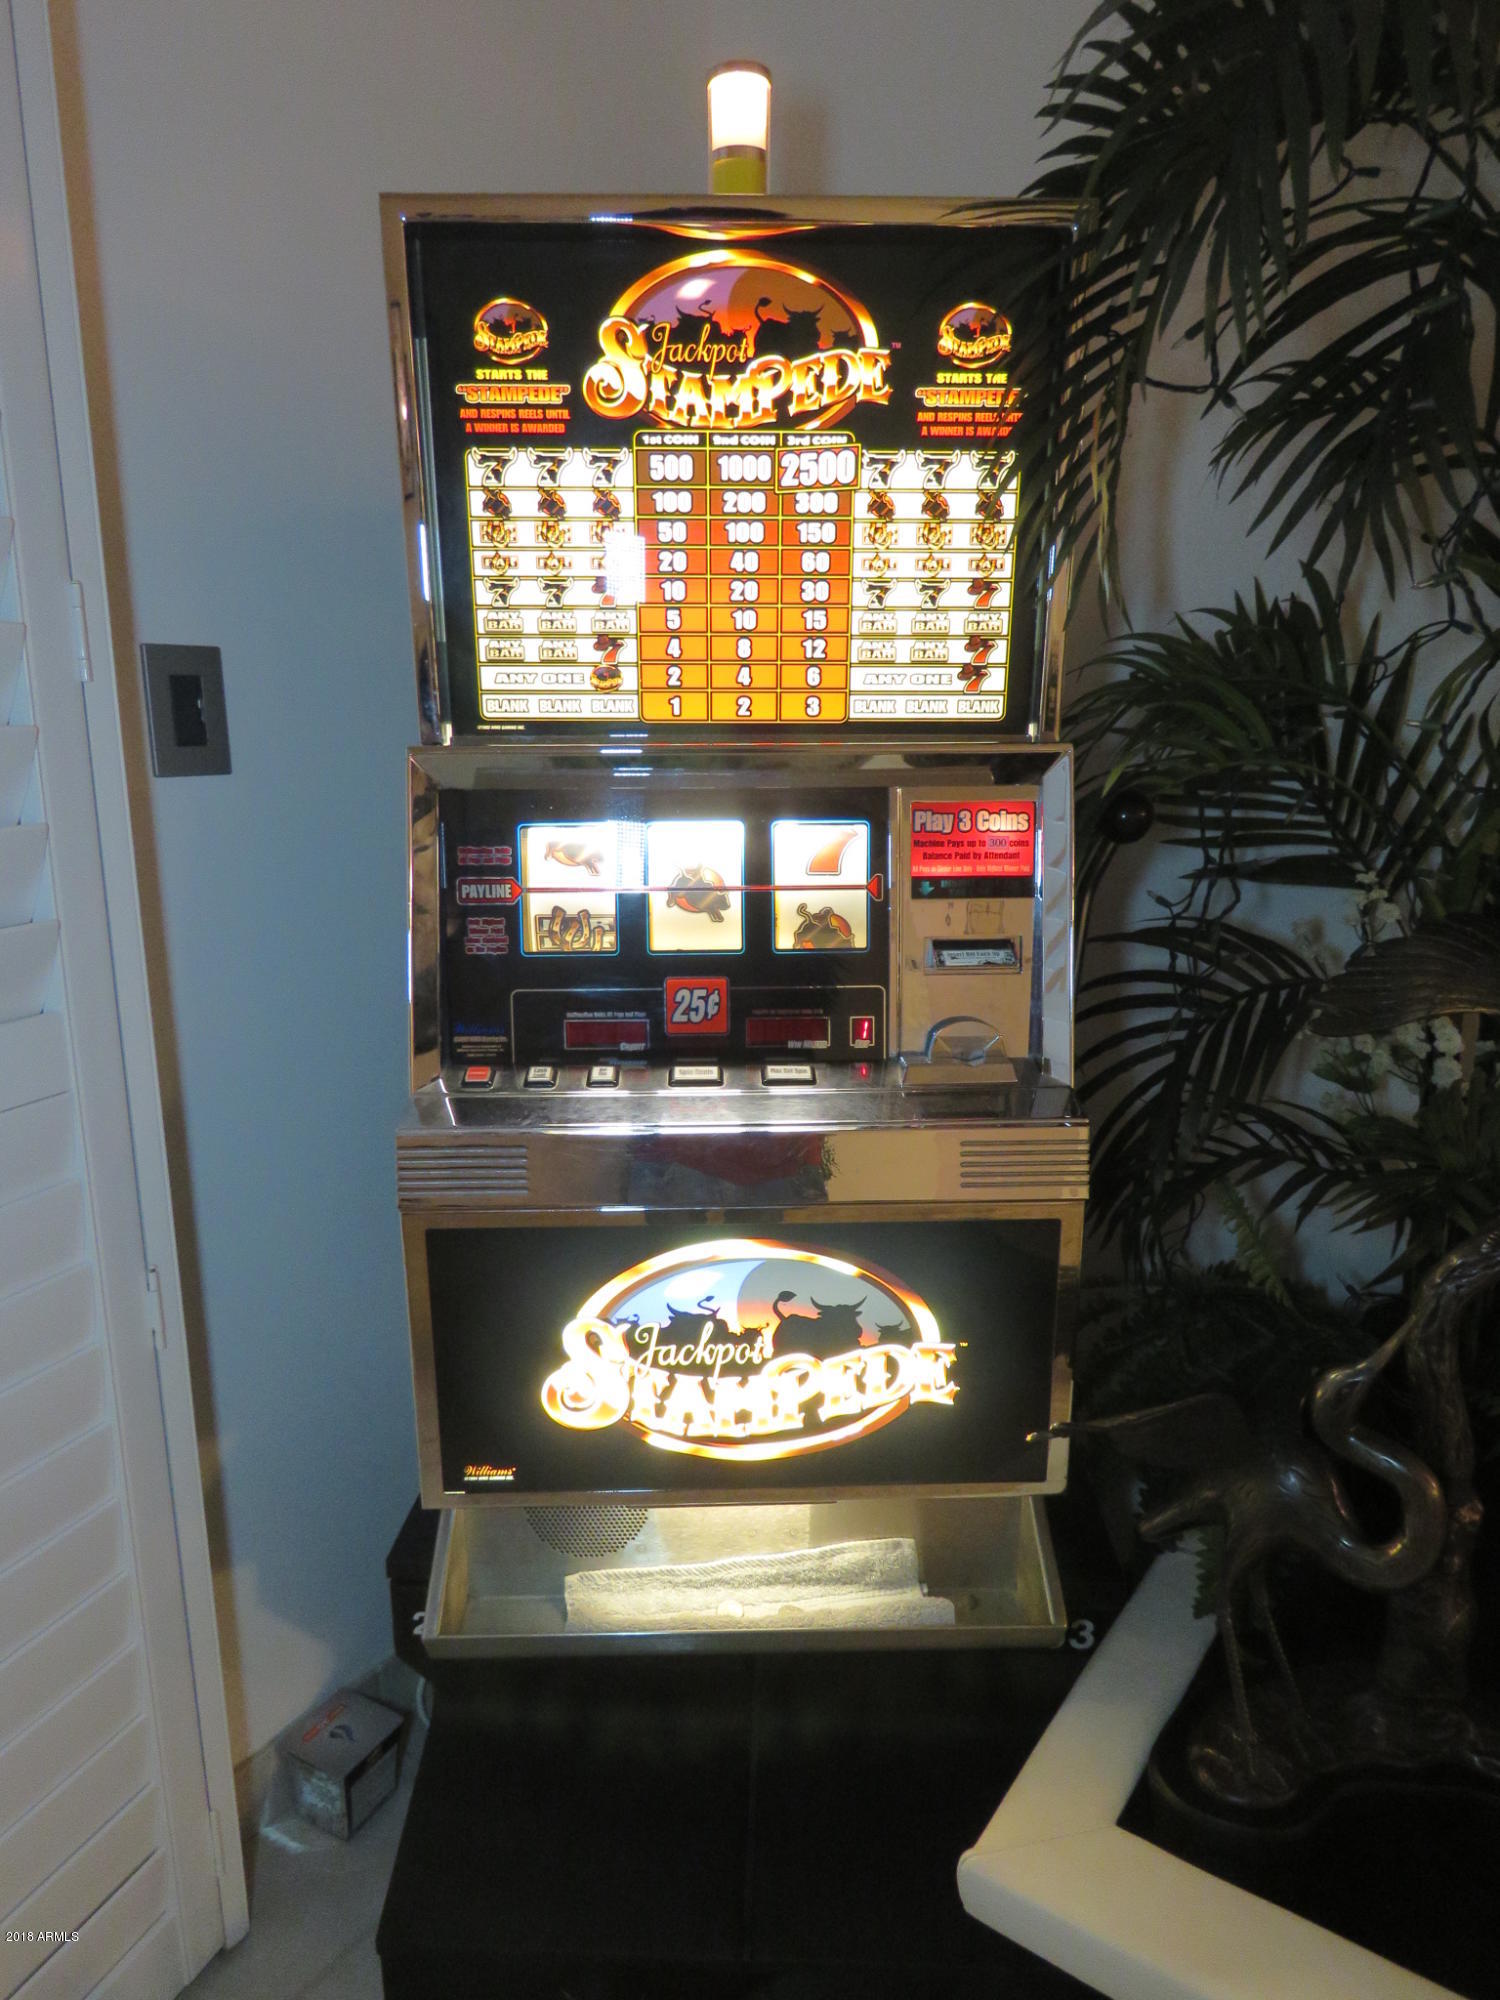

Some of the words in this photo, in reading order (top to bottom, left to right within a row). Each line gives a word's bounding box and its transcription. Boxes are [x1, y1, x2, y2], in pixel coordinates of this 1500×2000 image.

[652, 323, 748, 380] Jackpot
[476, 369, 522, 380] STARTS
[525, 369, 548, 380] THE
[583, 316, 894, 428] STAMPEDE
[936, 373, 982, 384] STARTS
[460, 409, 478, 419] AND
[518, 409, 544, 419] REELS
[546, 409, 571, 419] UNTIL
[917, 412, 935, 422] AND
[650, 454, 693, 482] 500
[718, 454, 772, 482] 1000
[780, 450, 856, 486] 2500
[652, 491, 692, 513] 100
[723, 491, 767, 513] 200
[795, 492, 839, 514] 300
[657, 521, 687, 543] 50
[725, 521, 765, 543] 100
[797, 521, 836, 543] 150
[658, 551, 687, 572] 20
[730, 551, 759, 572] 40
[801, 551, 831, 573] 60
[660, 580, 687, 601] 10
[730, 580, 759, 602] 20
[801, 580, 830, 602] 30
[666, 608, 681, 630] 5
[731, 609, 758, 630] 10
[802, 609, 828, 631] 15
[666, 637, 682, 658] 4
[737, 638, 752, 659] 8
[802, 638, 827, 659] 12
[495, 673, 538, 684] ANY
[541, 673, 585, 684] ONE
[666, 666, 682, 687] 2
[736, 666, 752, 686] 4
[806, 666, 821, 687] 6
[863, 674, 907, 685] ANY
[910, 674, 952, 685] ONE
[486, 699, 529, 713] BLANK
[539, 699, 582, 713] BLANK
[591, 699, 634, 713] BLANK
[669, 696, 681, 717] 1
[736, 696, 752, 717] 2
[805, 696, 821, 717] 3
[853, 700, 896, 713] BLANK
[905, 700, 948, 713] BLANK
[957, 700, 1000, 713] BLANK
[913, 809, 955, 833] Play
[958, 809, 972, 832] 3
[976, 809, 1030, 832] Coins
[947, 840, 964, 848] Pays
[989, 839, 1007, 847] 300
[923, 852, 952, 860] Balance
[462, 884, 512, 898] PAYLINE
[634, 1321, 766, 1379] Jackpot
[541, 1317, 960, 1438] STAMPEDE
[1069, 1619, 1095, 1650] 3
